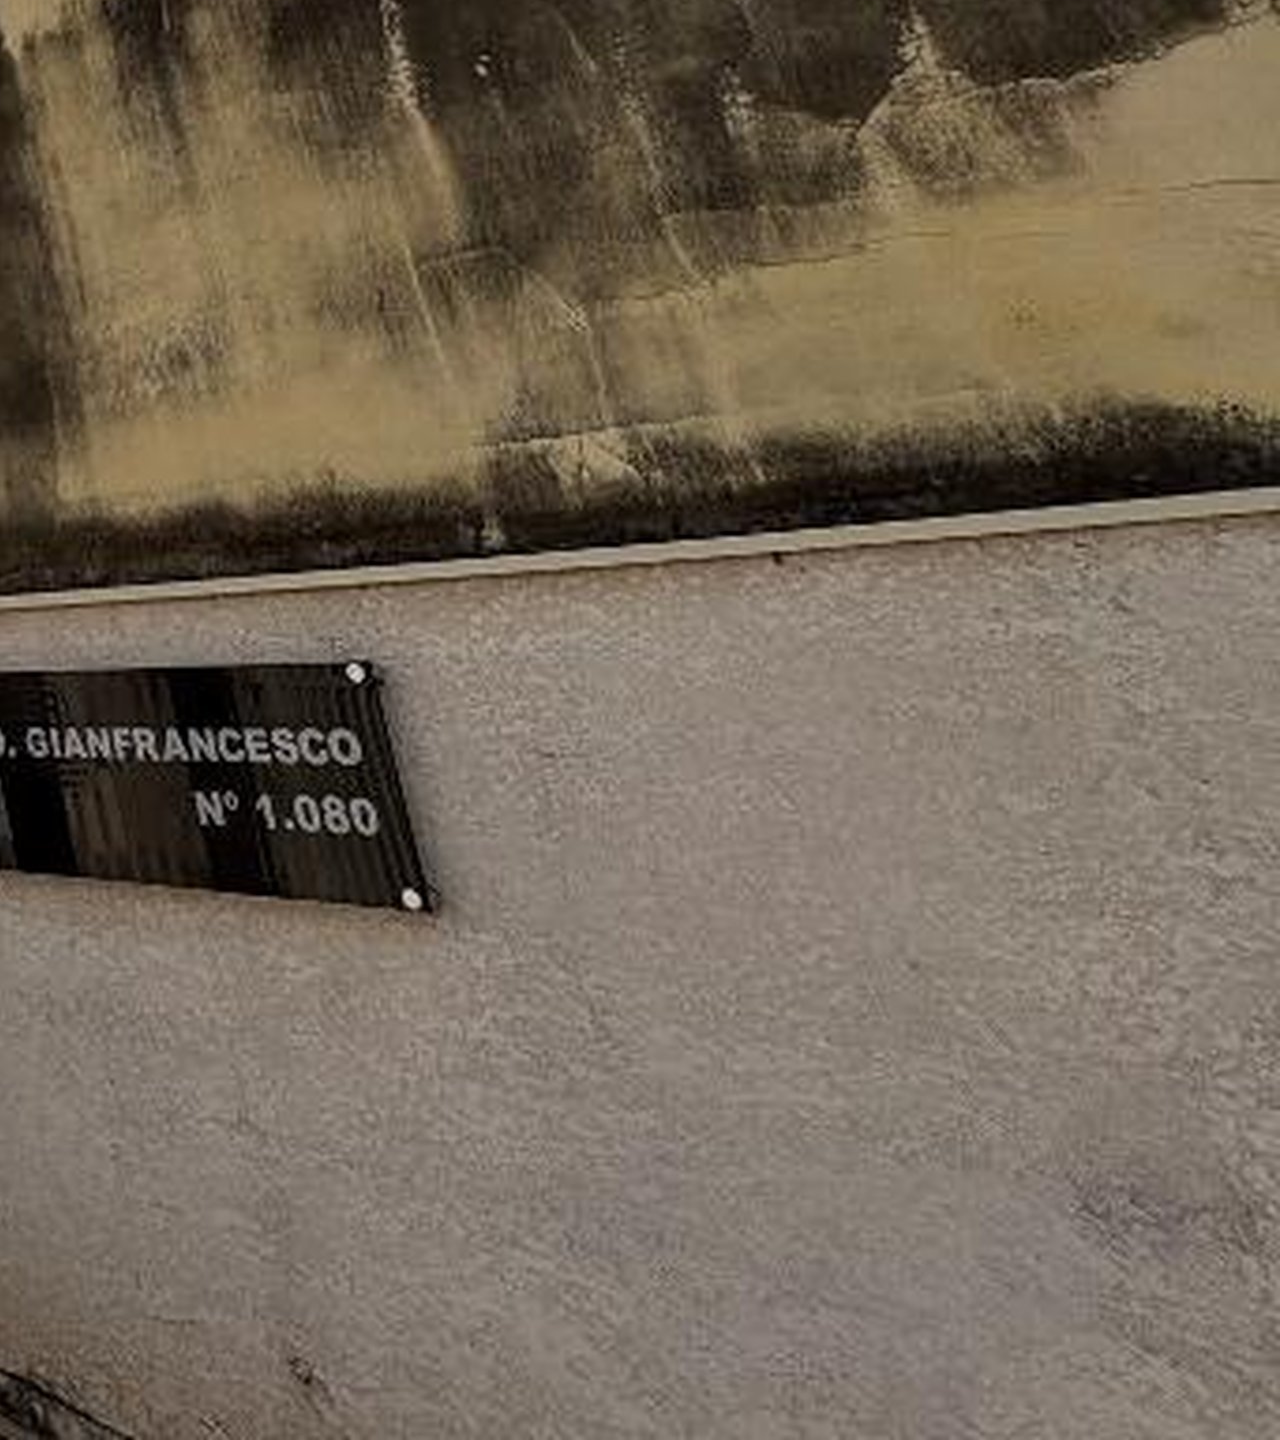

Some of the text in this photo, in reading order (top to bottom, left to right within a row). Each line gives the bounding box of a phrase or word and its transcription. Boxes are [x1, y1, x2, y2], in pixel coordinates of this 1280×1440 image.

[26, 726, 363, 767] GIANFRANCESCO
[195, 790, 380, 837] Nº 1.080
